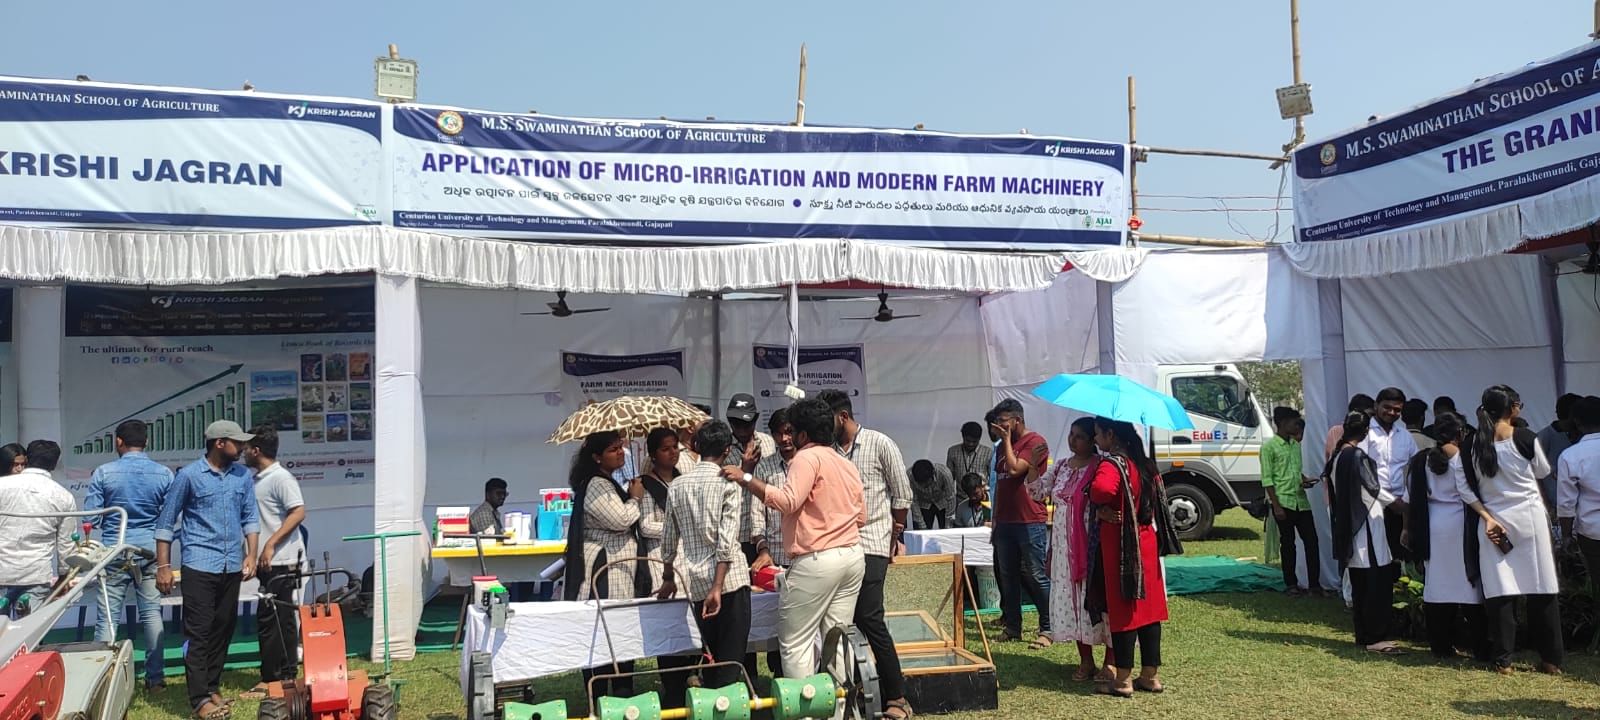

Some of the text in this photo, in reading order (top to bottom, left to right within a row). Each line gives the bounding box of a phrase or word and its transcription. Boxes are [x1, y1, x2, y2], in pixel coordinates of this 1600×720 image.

[74, 93, 121, 106] SCHOOL
[124, 98, 138, 107] OF
[142, 97, 220, 113] AGRICULTURE
[307, 107, 337, 116] KRISHI
[338, 110, 376, 119] JAGRAN
[1345, 137, 1375, 159] M.S.
[1378, 101, 1485, 149] SWAMINATHAN
[1489, 79, 1559, 113] SCHOOL
[1561, 67, 1585, 89] OF
[482, 117, 766, 144] M.S. SWAMINATHAN SCHOOL OF AGRICULTURE
[1442, 106, 1600, 174] THE GRAN
[1061, 146, 1085, 155] KRISHI
[1086, 147, 1115, 156] JAGRAN
[132, 158, 283, 187] JAGRAN
[422, 152, 1104, 197] APPLICATION OF MICRO-IRRIGATION AND MODERN FARM MACHINERY
[1305, 154, 1600, 237] Centurion University of Technology and Management, Paralakhemundi, Gaj
[399, 212, 436, 220] Centurion
[438, 213, 474, 222] University
[487, 215, 524, 224] Technology
[645, 221, 673, 229] Gajapati
[80, 344, 214, 354] The ultimate for rural reach
[605, 380, 668, 388] MECHANISATION
[1192, 430, 1228, 440] EduEx
